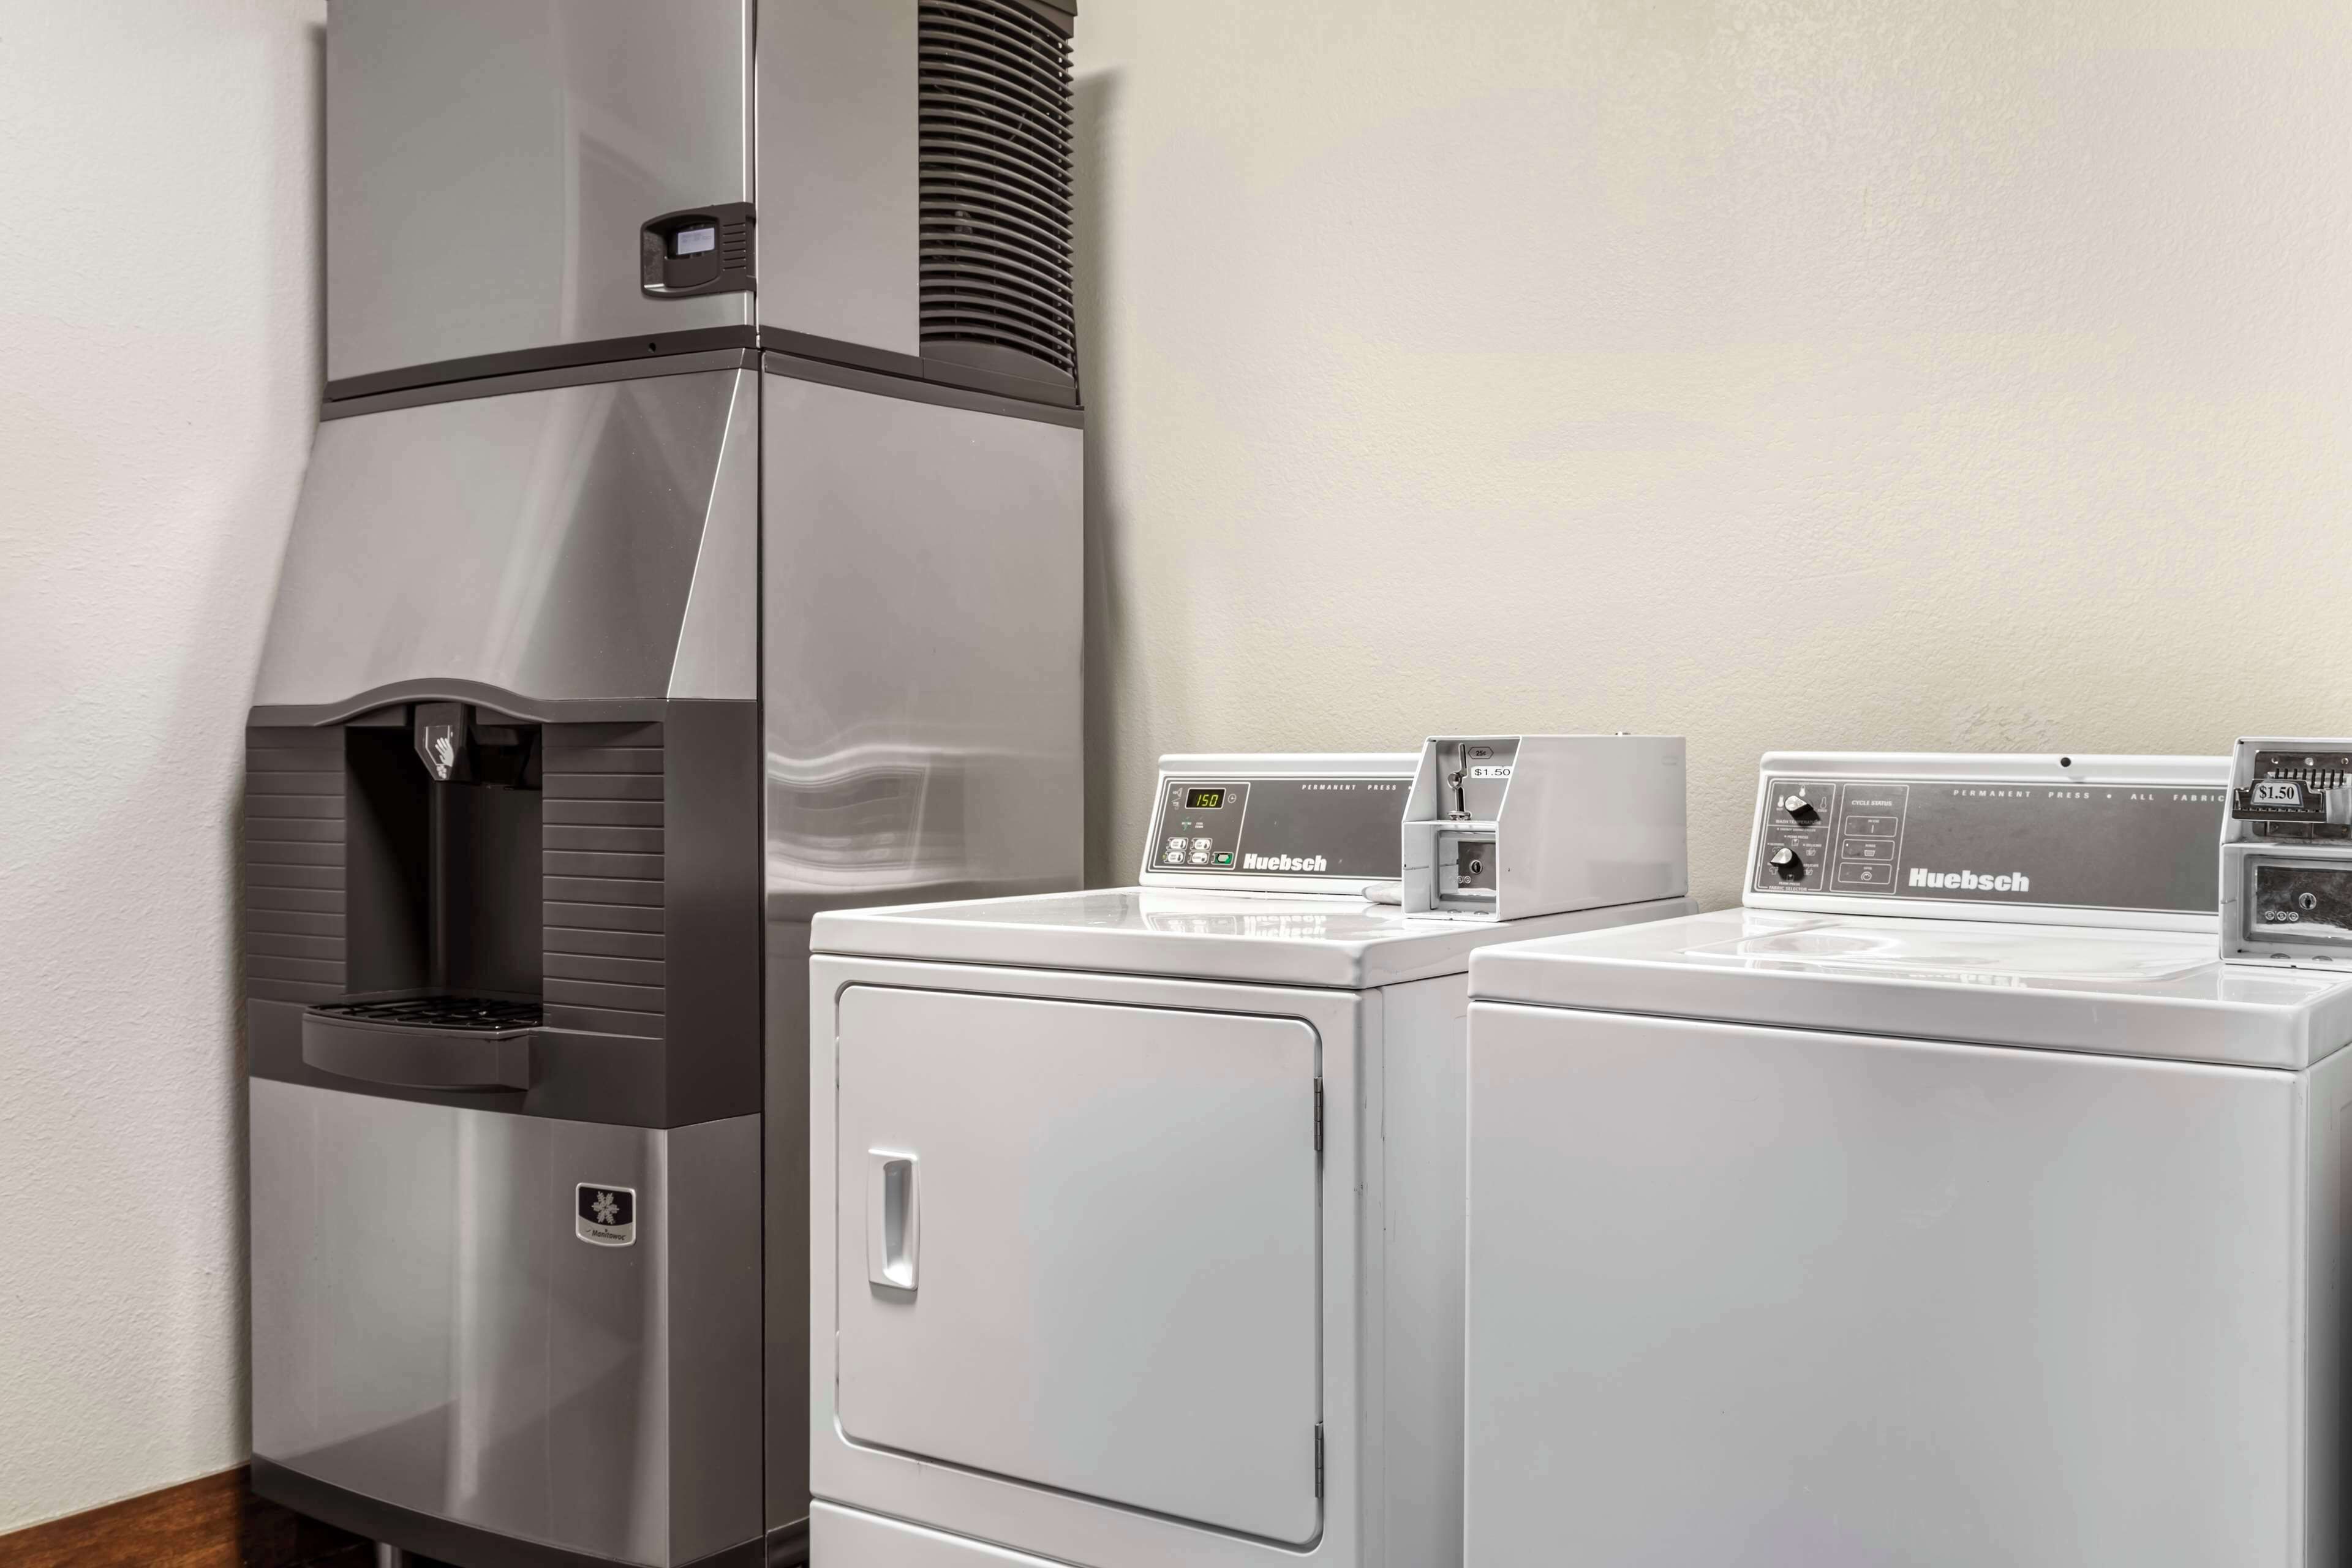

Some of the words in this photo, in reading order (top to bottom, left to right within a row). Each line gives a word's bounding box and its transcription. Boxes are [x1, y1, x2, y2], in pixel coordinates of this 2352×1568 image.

[1196, 794, 1219, 807] 150
[2260, 785, 2294, 800] $1.50
[1243, 853, 1327, 871] Huebsch
[1909, 868, 2029, 892] Huebsch
